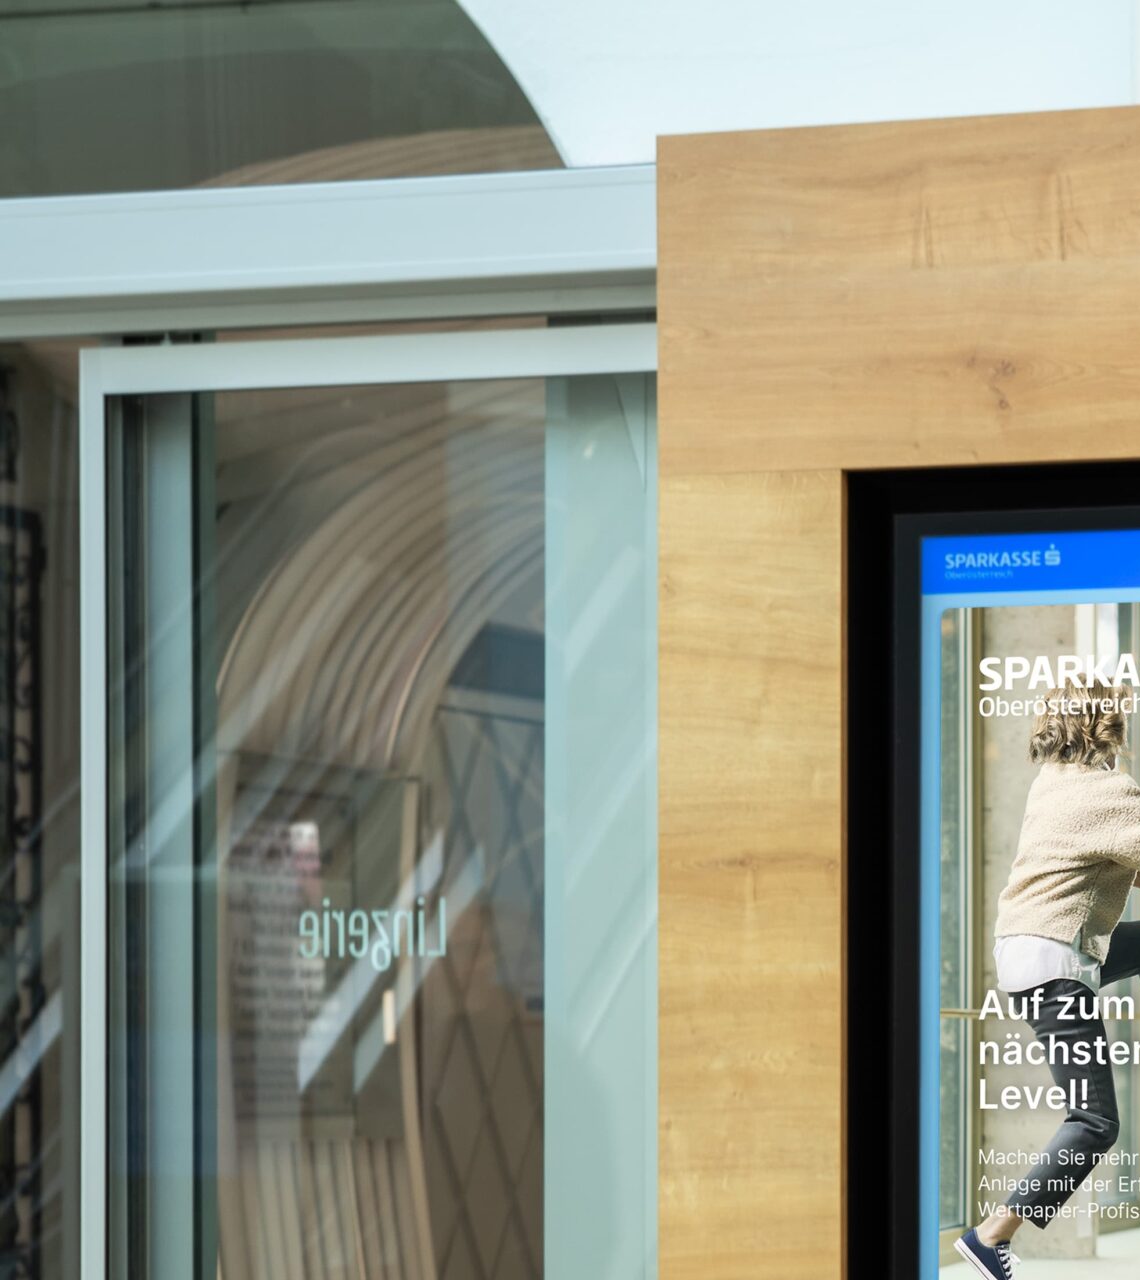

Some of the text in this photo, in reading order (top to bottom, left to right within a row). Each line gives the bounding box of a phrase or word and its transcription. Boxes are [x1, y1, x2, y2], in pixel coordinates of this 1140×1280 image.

[944, 550, 1041, 569] SPARKASSE
[978, 988, 1135, 1021] Auf zum
[979, 1078, 1088, 1110] Level!
[978, 1149, 1051, 1166] Machen
[1057, 1149, 1085, 1166] Sie
[1092, 1149, 1139, 1166] mehr
[978, 1175, 1041, 1196] Anlage
[1047, 1175, 1076, 1192] mit
[1082, 1175, 1112, 1193] der
